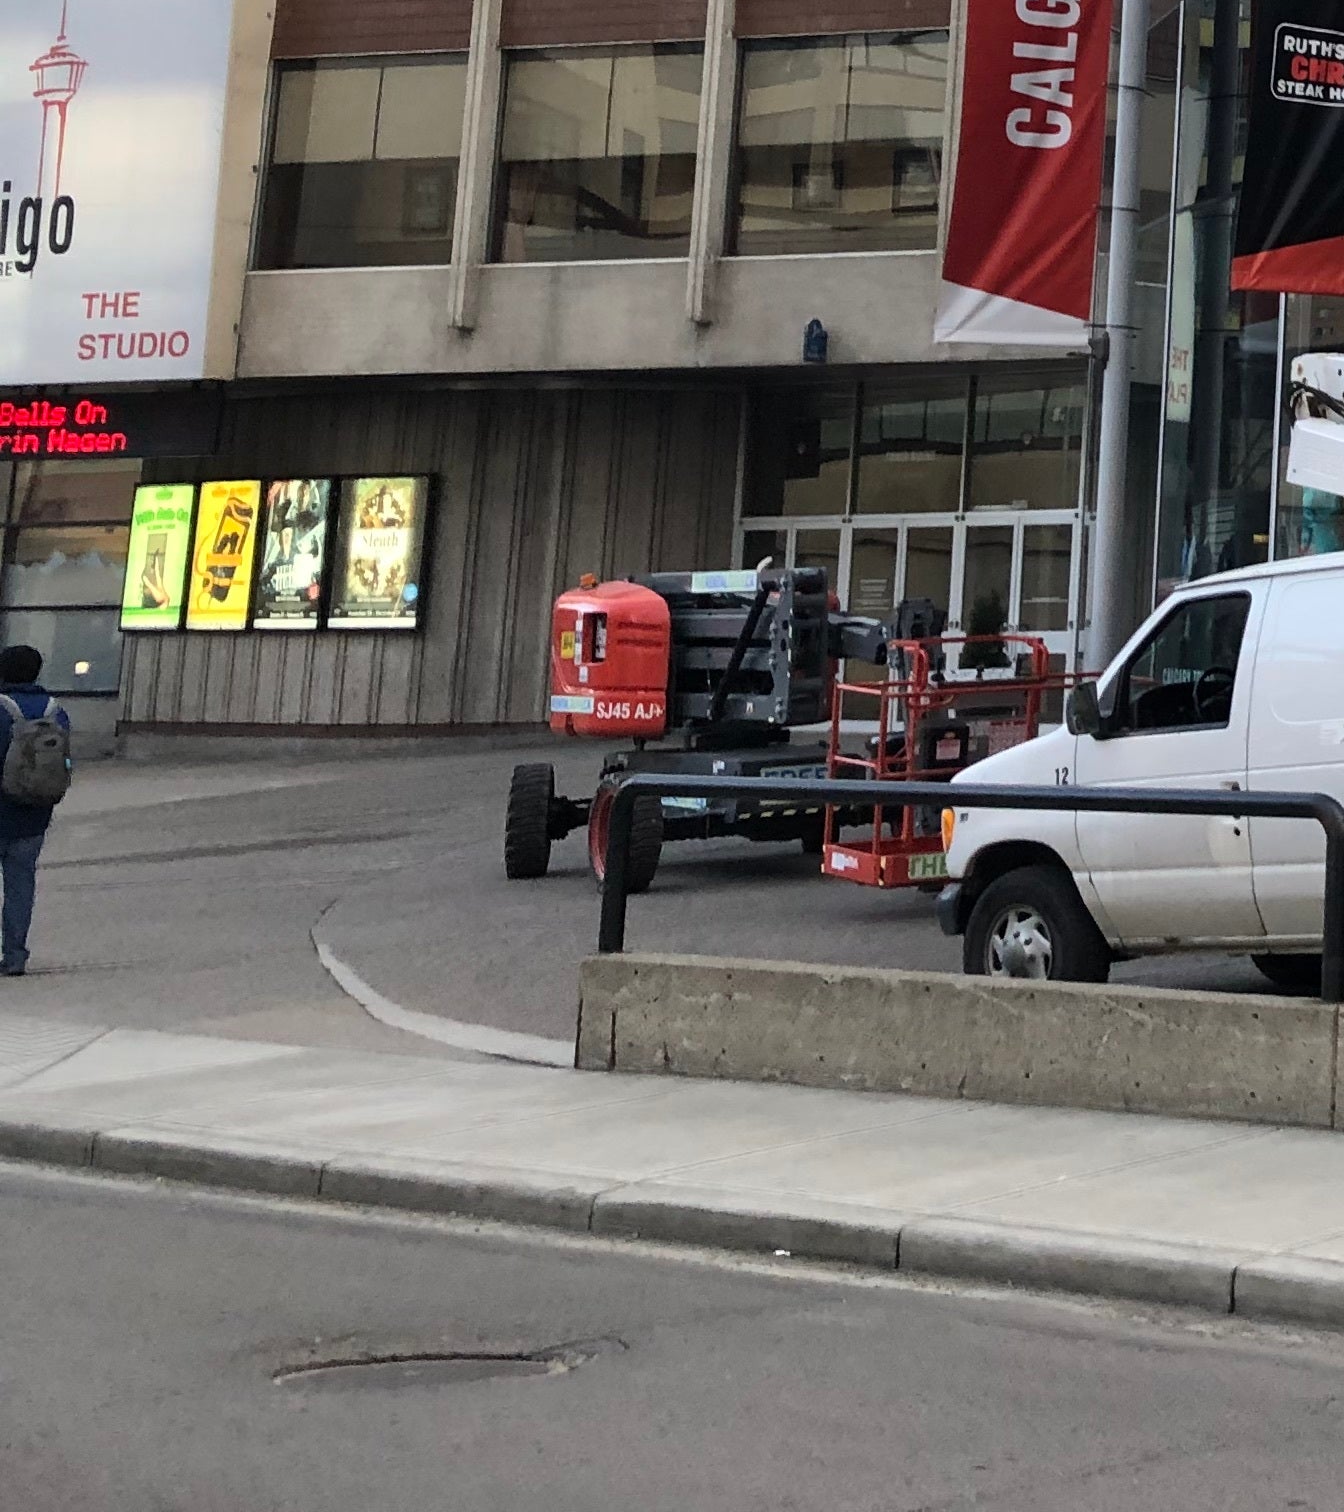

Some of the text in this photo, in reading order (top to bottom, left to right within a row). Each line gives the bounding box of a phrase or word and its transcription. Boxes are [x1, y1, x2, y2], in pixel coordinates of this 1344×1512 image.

[1277, 79, 1325, 98] STEAK
[82, 292, 140, 320] THE
[77, 330, 189, 361] STUDIO
[75, 400, 108, 426] On
[596, 701, 630, 719] SJ45
[1055, 766, 1069, 786] 12
